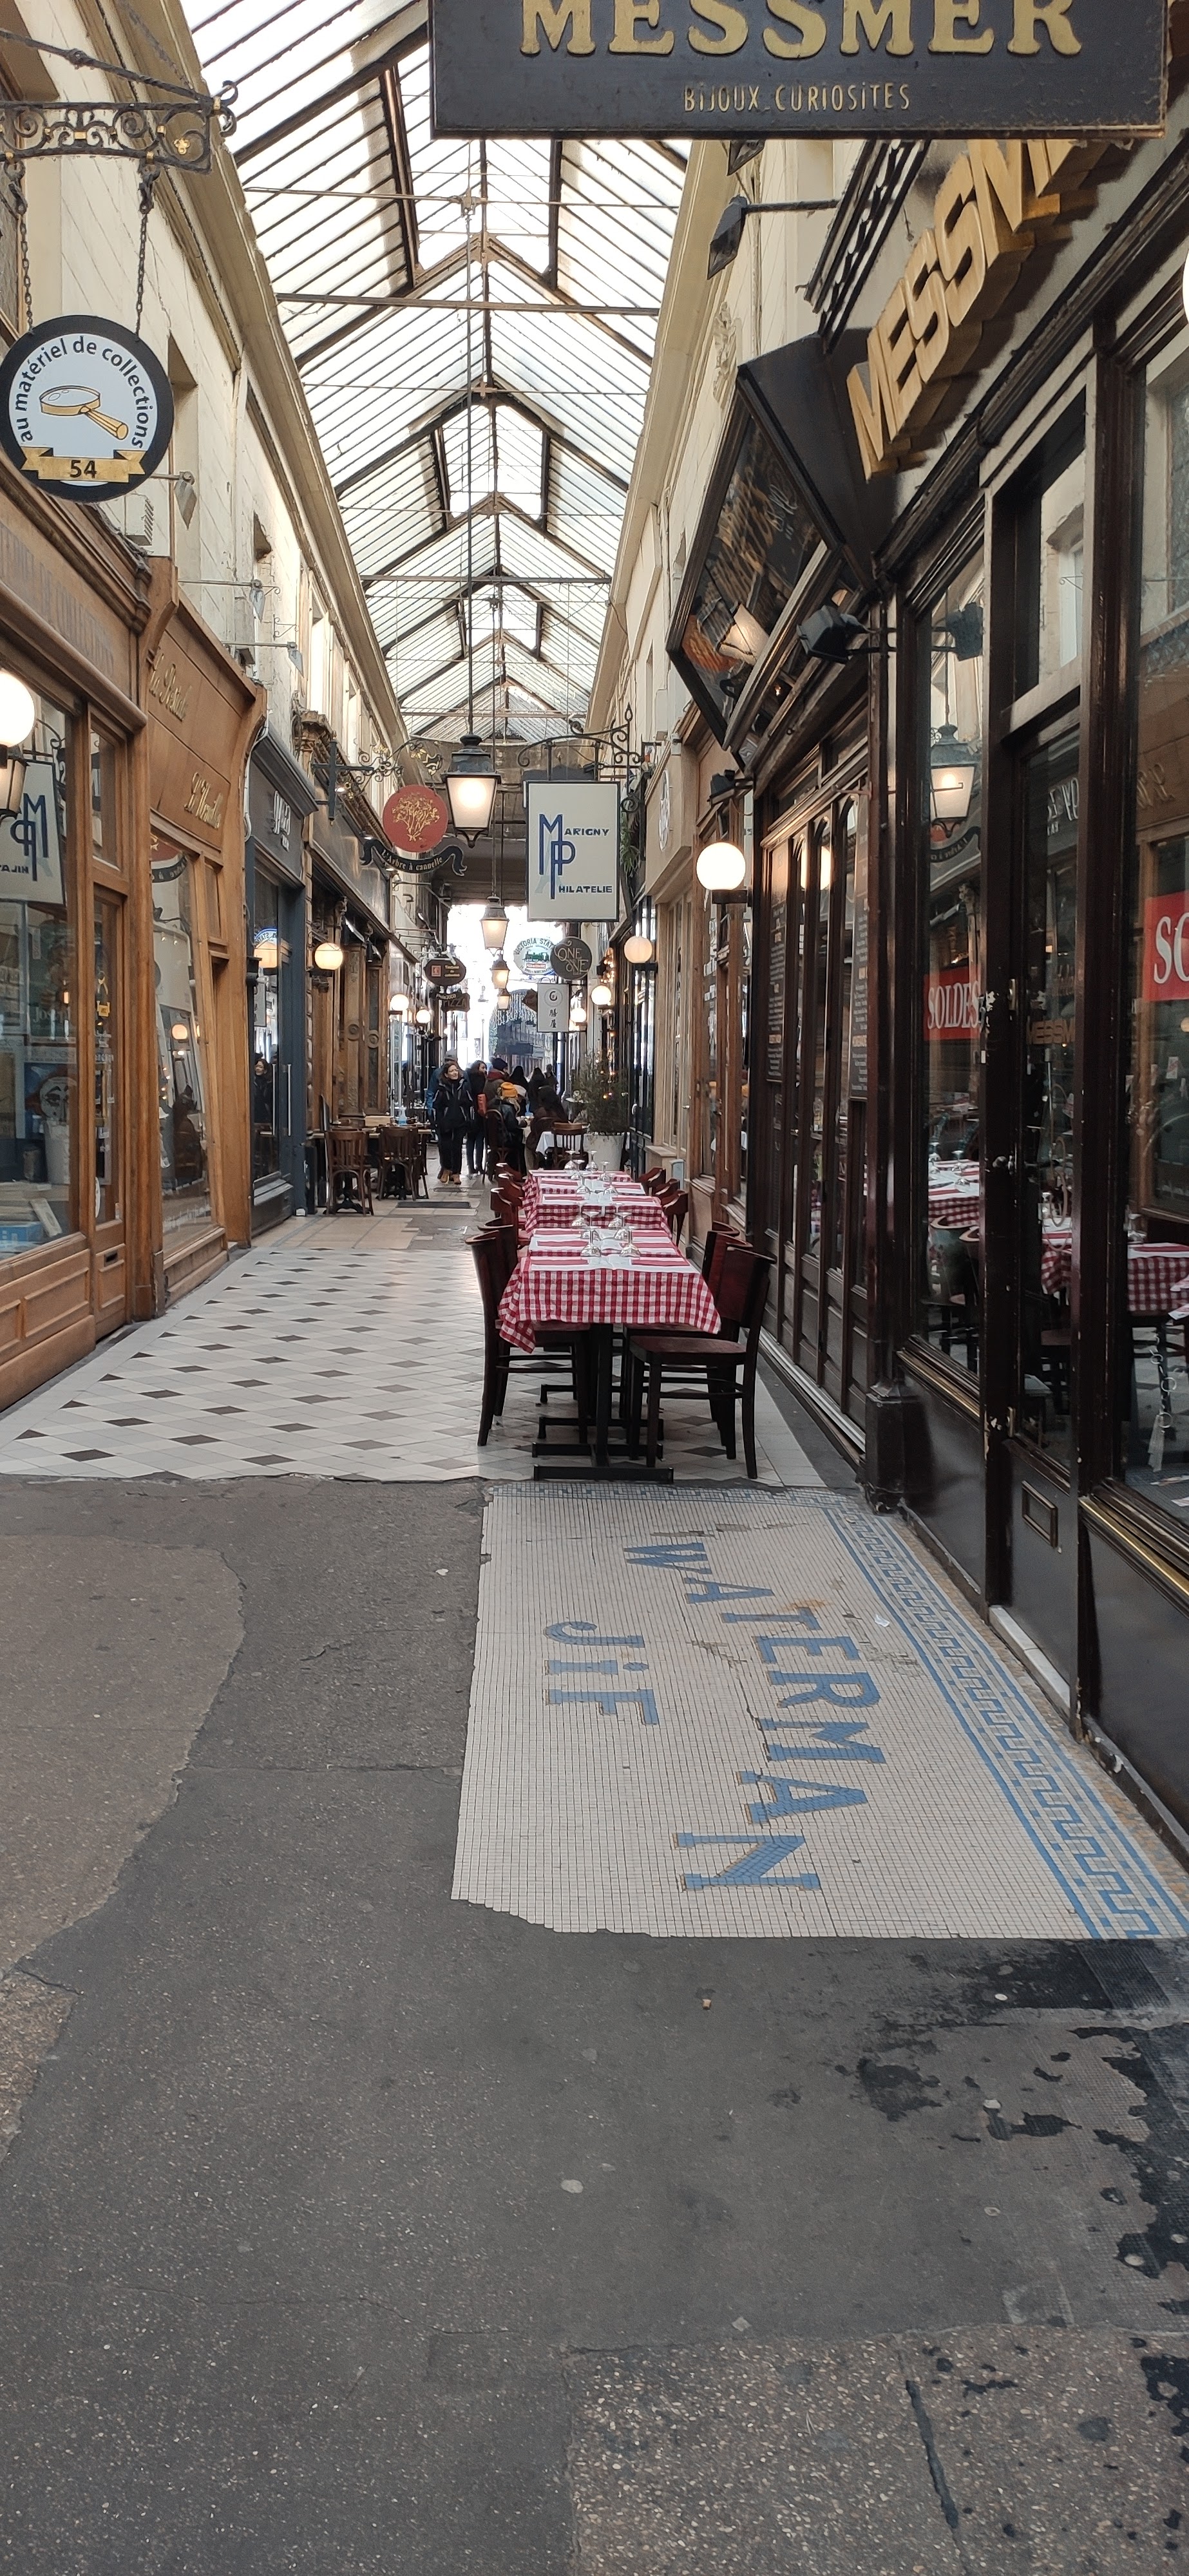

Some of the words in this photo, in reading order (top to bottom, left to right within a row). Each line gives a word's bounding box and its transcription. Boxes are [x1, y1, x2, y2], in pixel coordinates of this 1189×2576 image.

[520, 0, 1082, 60] MESSMER
[846, 138, 1074, 484] MESSM
[72, 335, 97, 355] de
[15, 337, 68, 412] matériel
[101, 345, 154, 450] collections
[15, 417, 33, 443] au
[70, 459, 98, 480] 54
[381, 849, 406, 869] L'Arbre
[408, 862, 414, 871] à
[415, 857, 443, 871] cannelle
[540, 938, 554, 949] STAT
[927, 981, 980, 1029] SOLDES
[623, 1541, 886, 1891] WATERMAN
